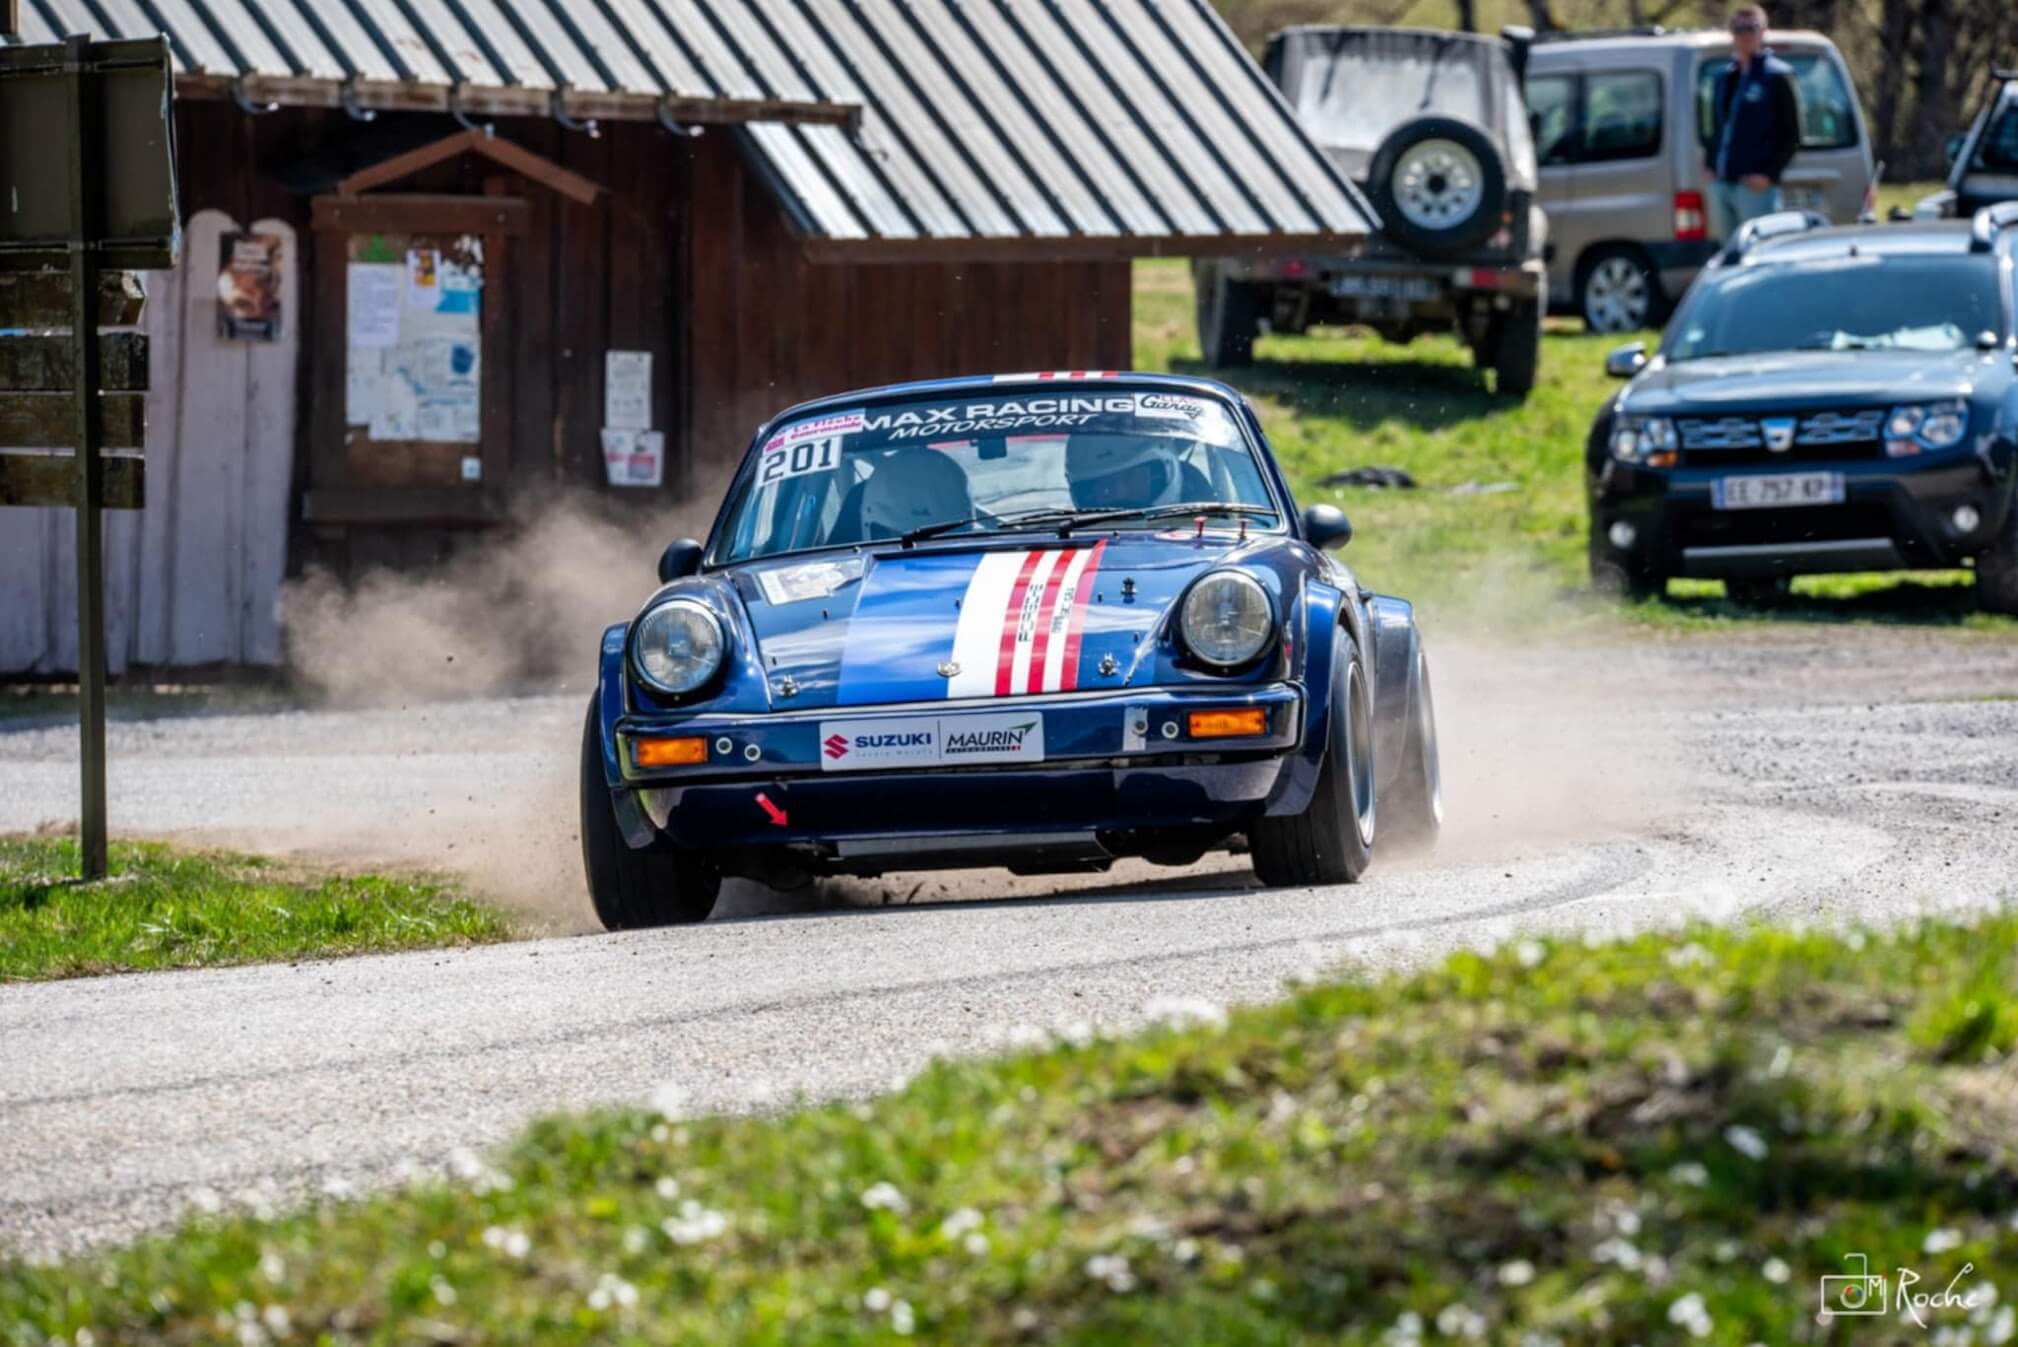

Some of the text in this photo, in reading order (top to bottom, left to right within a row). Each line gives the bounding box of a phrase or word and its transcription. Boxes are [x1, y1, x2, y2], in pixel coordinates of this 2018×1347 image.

[863, 406, 958, 431] MAX
[965, 398, 1134, 419] RACING
[888, 413, 1099, 441] MOTORSPORT
[763, 438, 832, 482] 201
[855, 732, 932, 748] SUZUKI
[947, 730, 1024, 747] MAURIN
